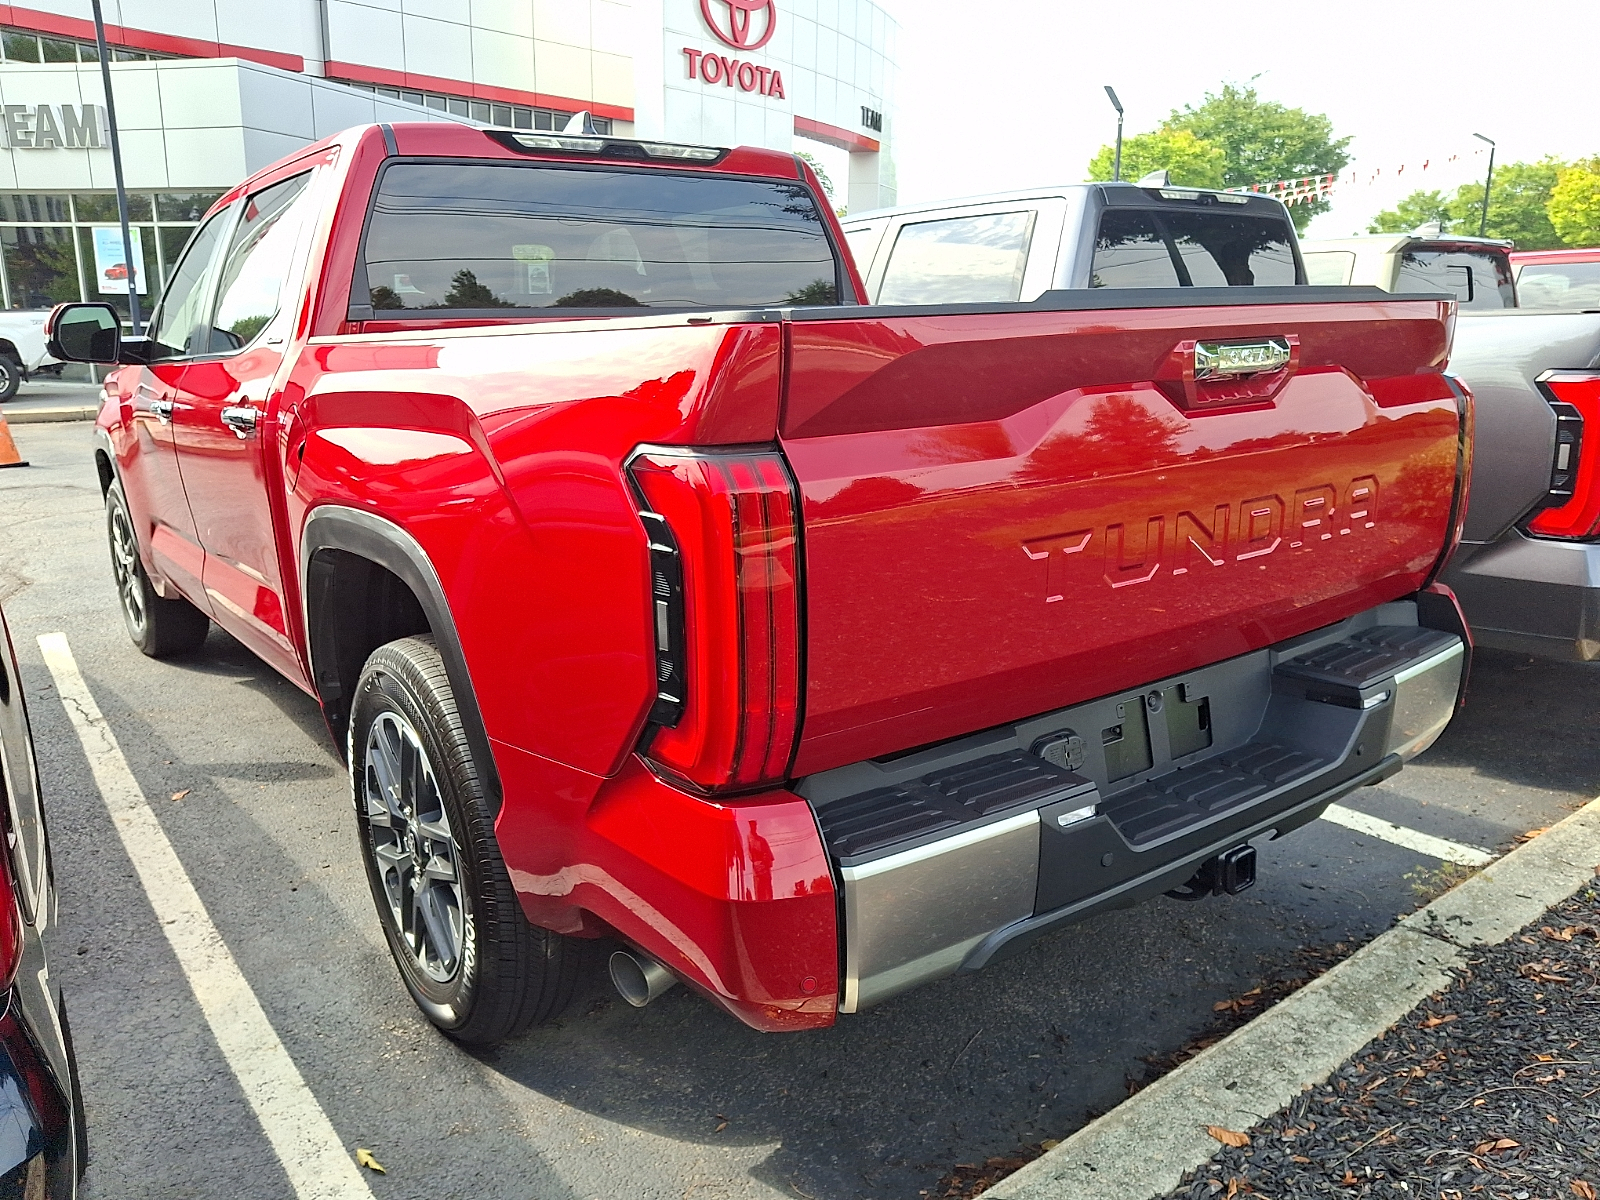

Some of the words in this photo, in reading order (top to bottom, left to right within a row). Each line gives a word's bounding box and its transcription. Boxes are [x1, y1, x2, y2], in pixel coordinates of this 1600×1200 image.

[683, 47, 785, 100] TOYOTA
[0, 104, 101, 147] EAM
[860, 105, 882, 133] TEAM
[1021, 474, 1380, 603] TUNDRA
